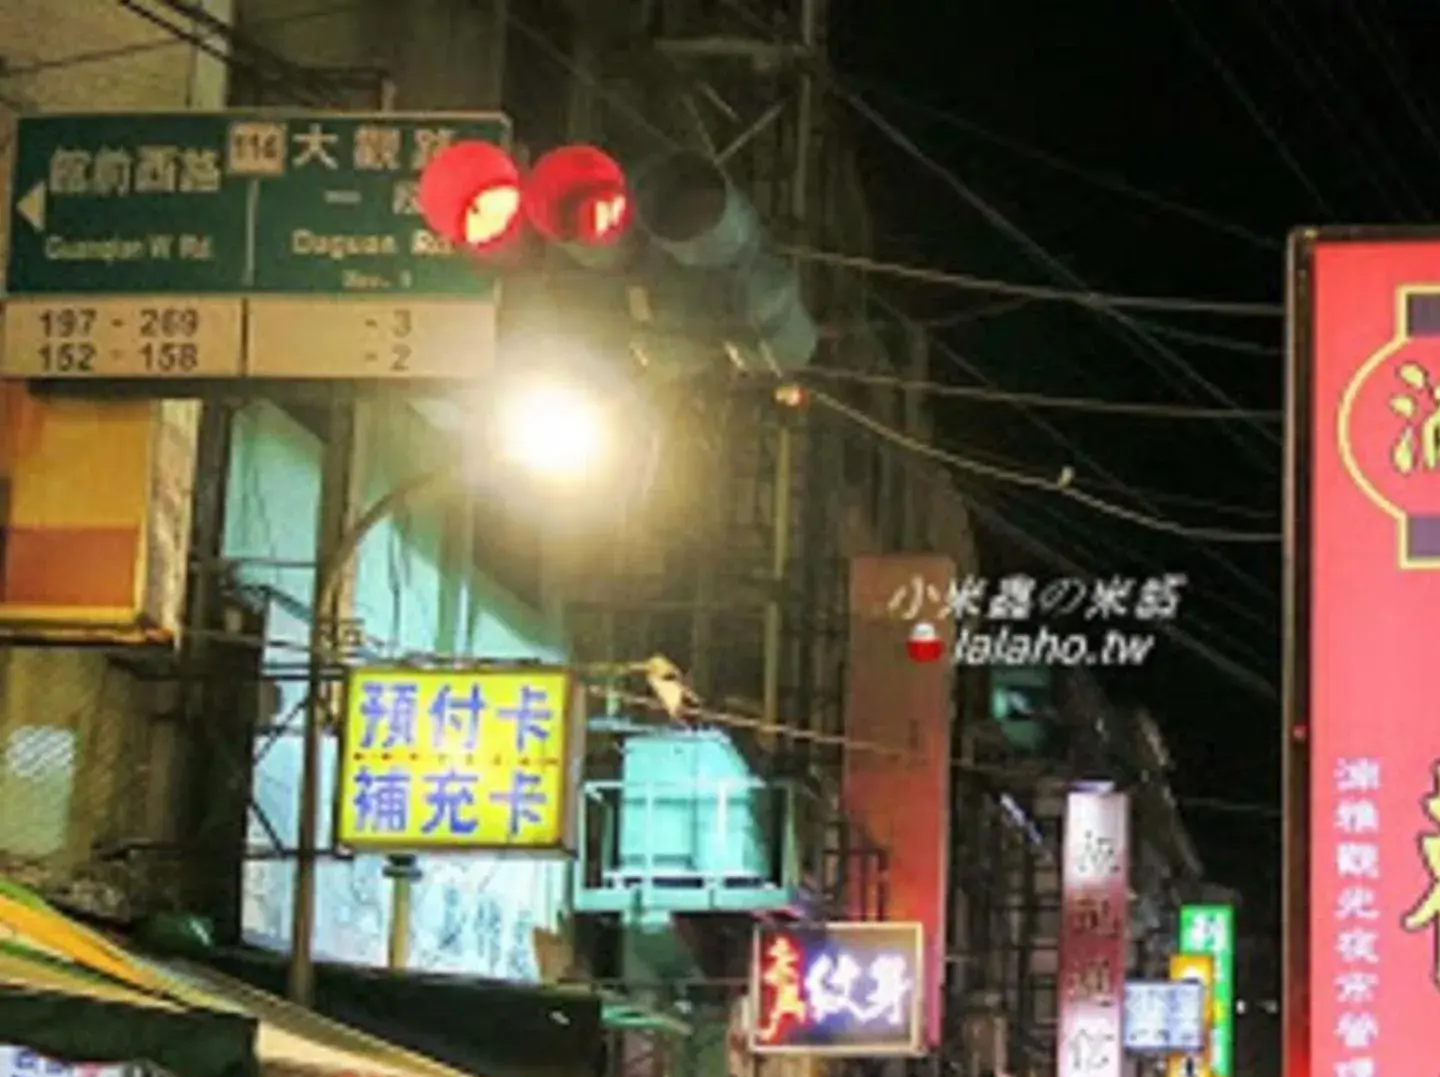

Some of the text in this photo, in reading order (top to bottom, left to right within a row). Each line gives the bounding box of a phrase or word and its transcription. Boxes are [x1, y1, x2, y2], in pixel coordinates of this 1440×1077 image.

[292, 229, 397, 259] Daguan
[39, 309, 98, 338] 197
[139, 309, 199, 338] 269
[38, 343, 98, 372] 152
[139, 343, 199, 372] 158
[391, 343, 412, 372] 2
[360, 682, 553, 753] 預付卡
[354, 766, 547, 836] 補充卡
